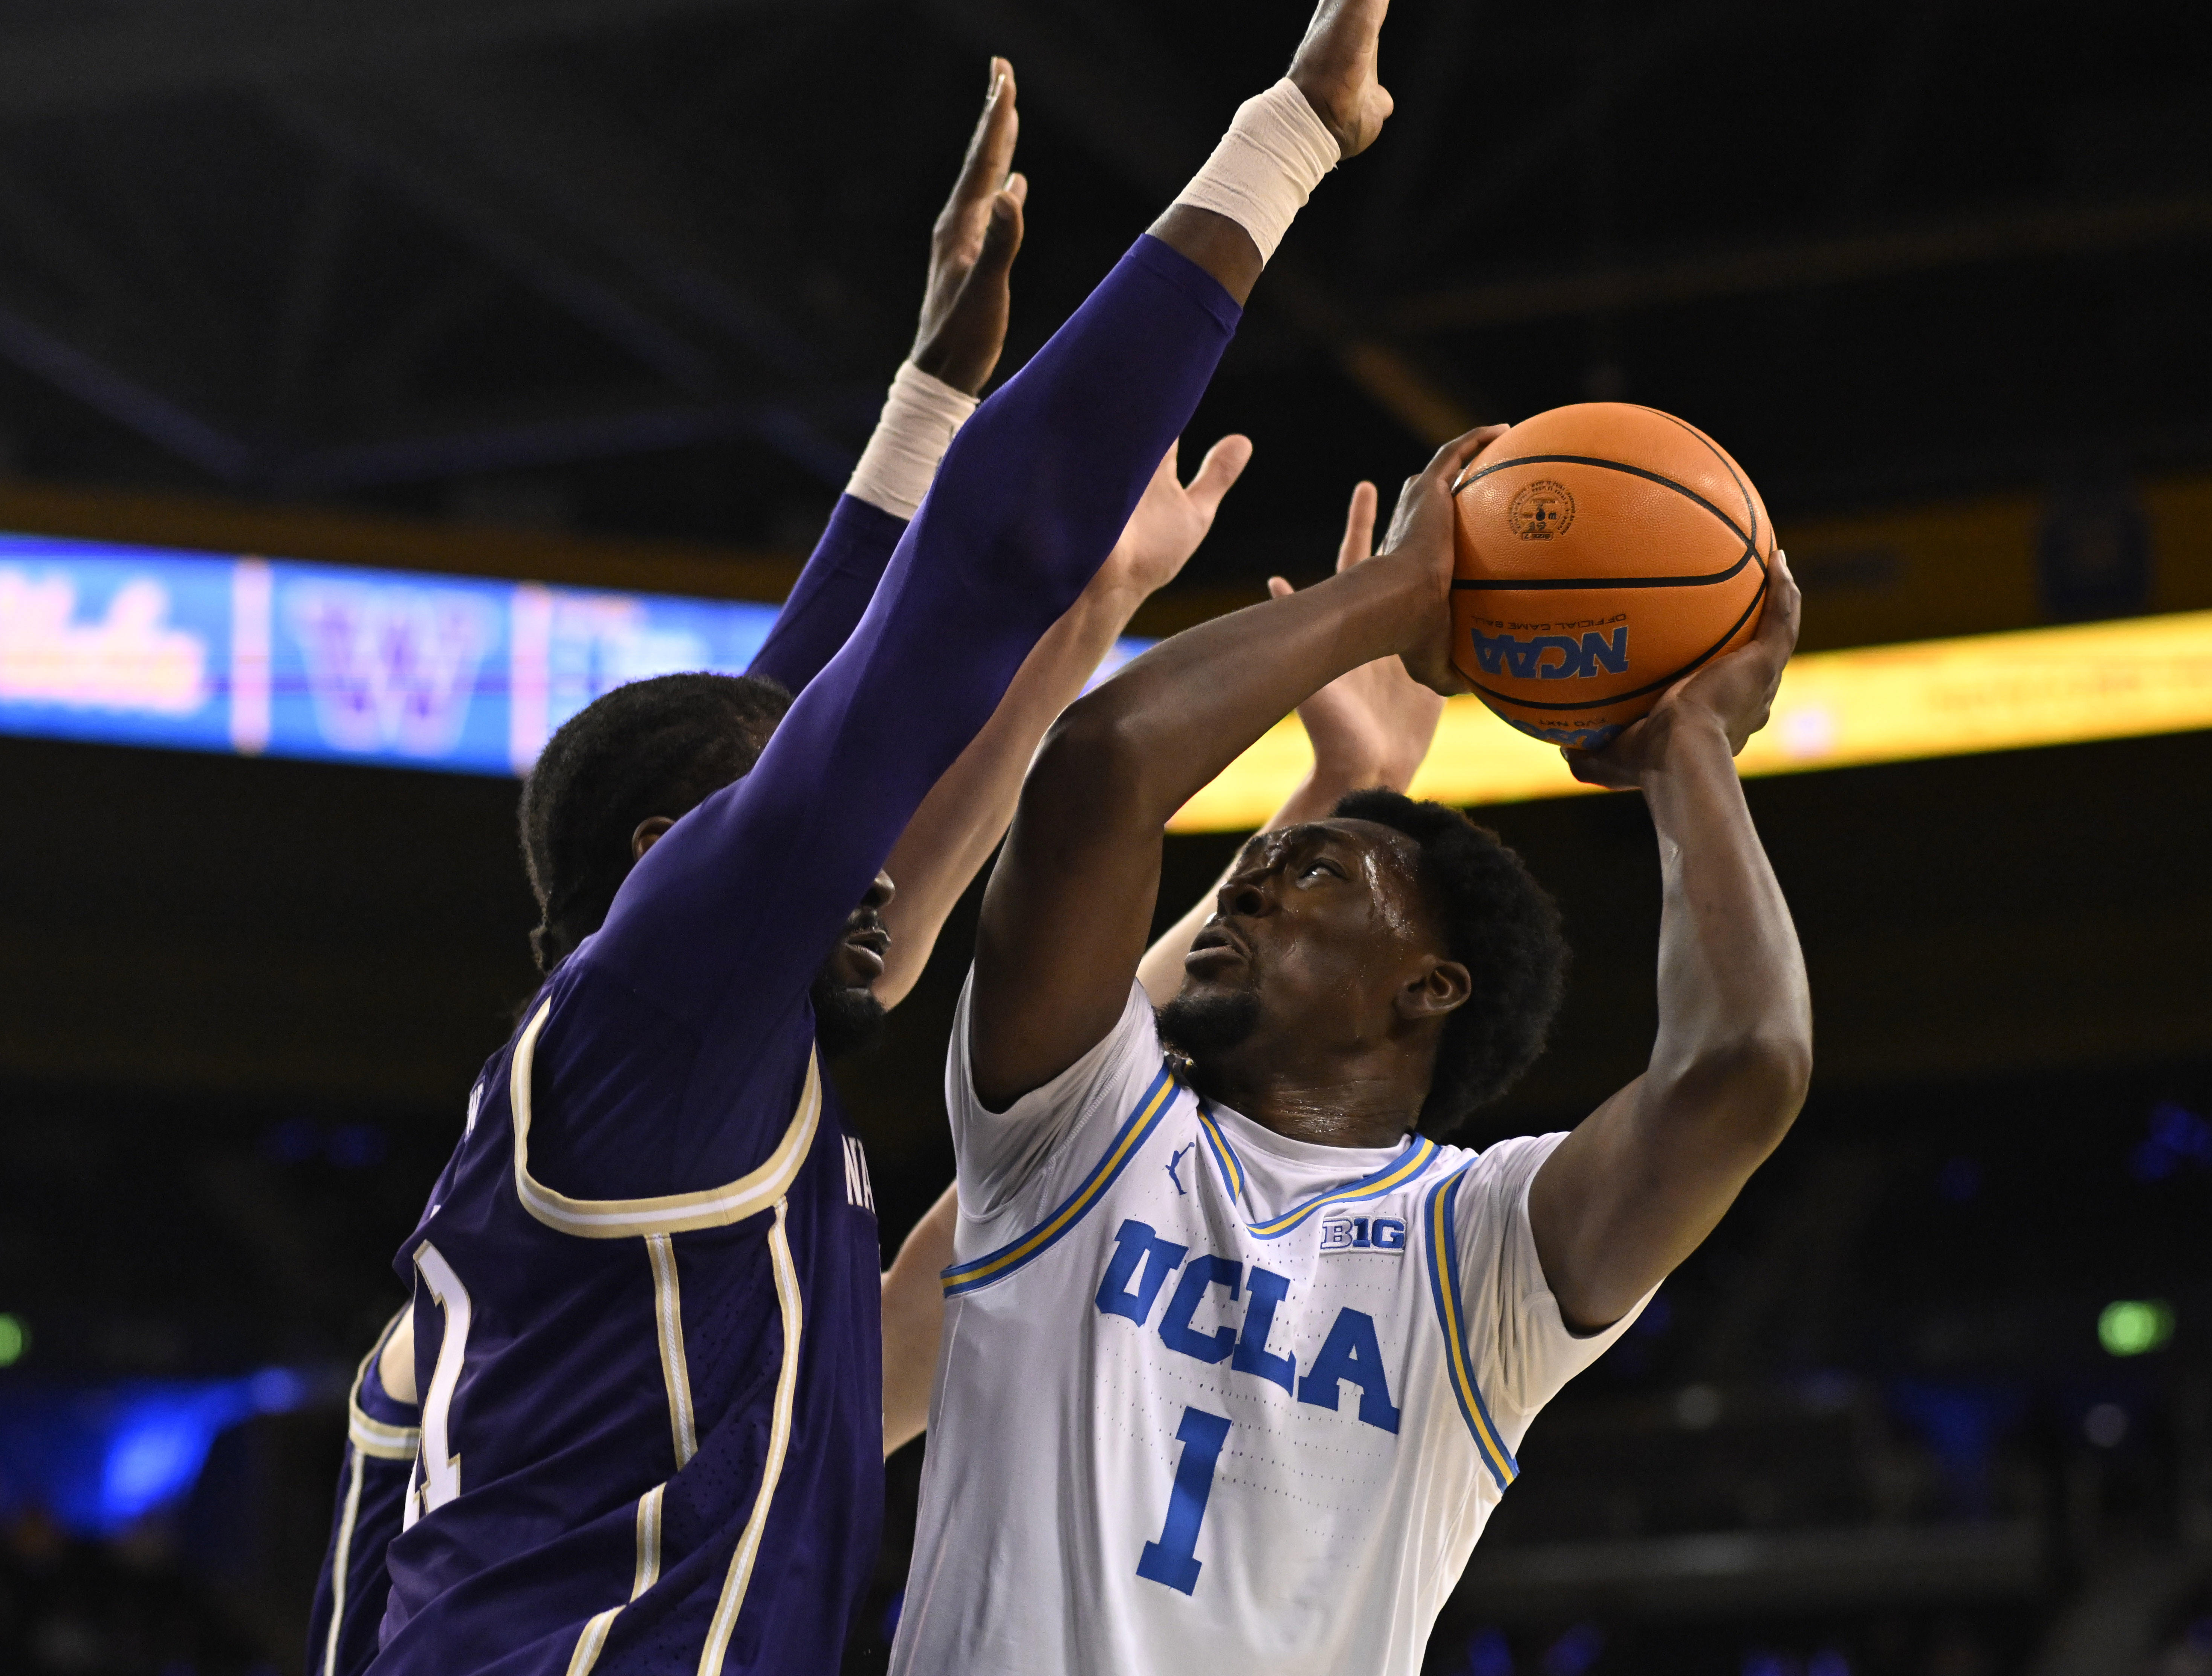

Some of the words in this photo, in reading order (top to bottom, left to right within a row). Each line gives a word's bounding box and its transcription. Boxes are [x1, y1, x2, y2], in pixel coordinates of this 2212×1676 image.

[1471, 615, 1504, 628] BALL
[1508, 622, 1551, 631] GAME
[1555, 613, 1627, 630] OFFICIAL
[1470, 625, 1630, 679] NCAA
[1094, 1218, 1400, 1435] UCLA
[1136, 1406, 1232, 1597] 1
